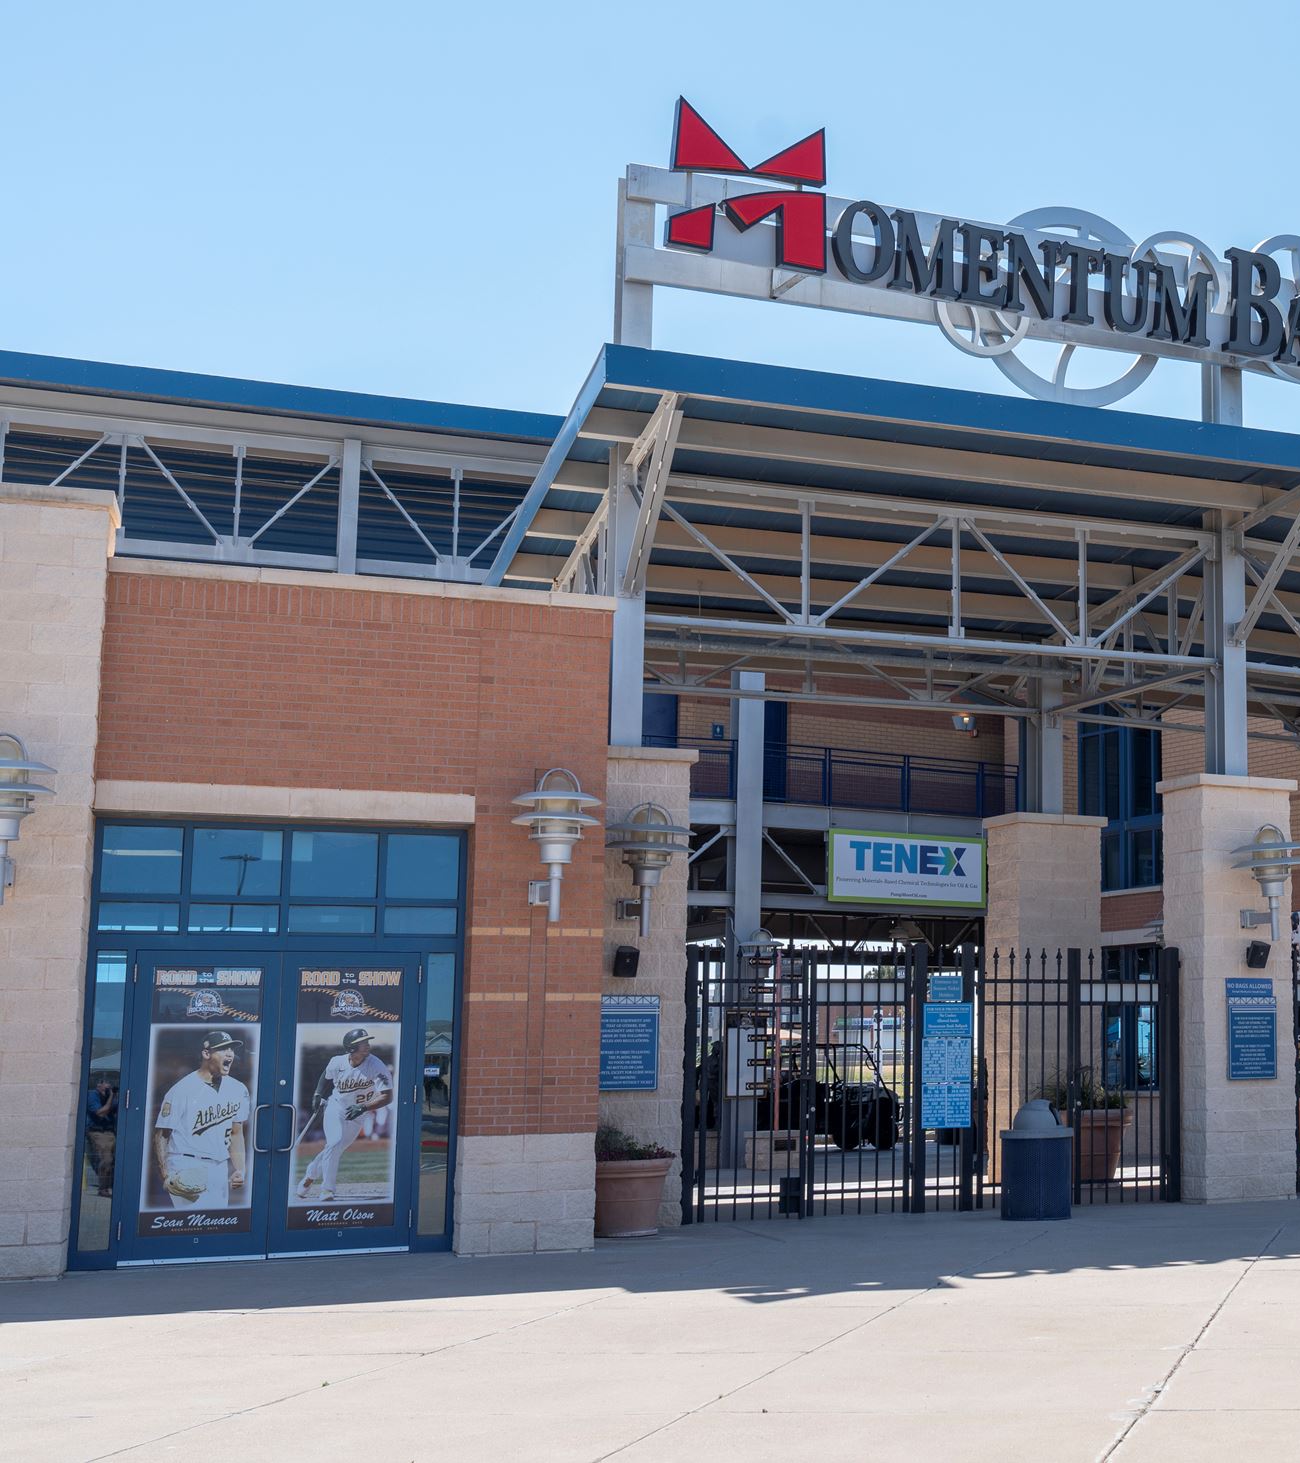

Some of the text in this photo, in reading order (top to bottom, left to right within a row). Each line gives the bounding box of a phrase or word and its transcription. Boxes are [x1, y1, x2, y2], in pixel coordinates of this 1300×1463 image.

[849, 840, 967, 877] TENEX
[836, 876, 861, 884] Pioneering
[920, 880, 949, 888] Technologies
[155, 969, 198, 986] ROAD
[216, 970, 262, 986] SHOW
[301, 970, 341, 986] ROAD
[358, 971, 402, 986] SHOW
[150, 1213, 239, 1229] Sean Manaea
[306, 1208, 375, 1222] Matt Olson
